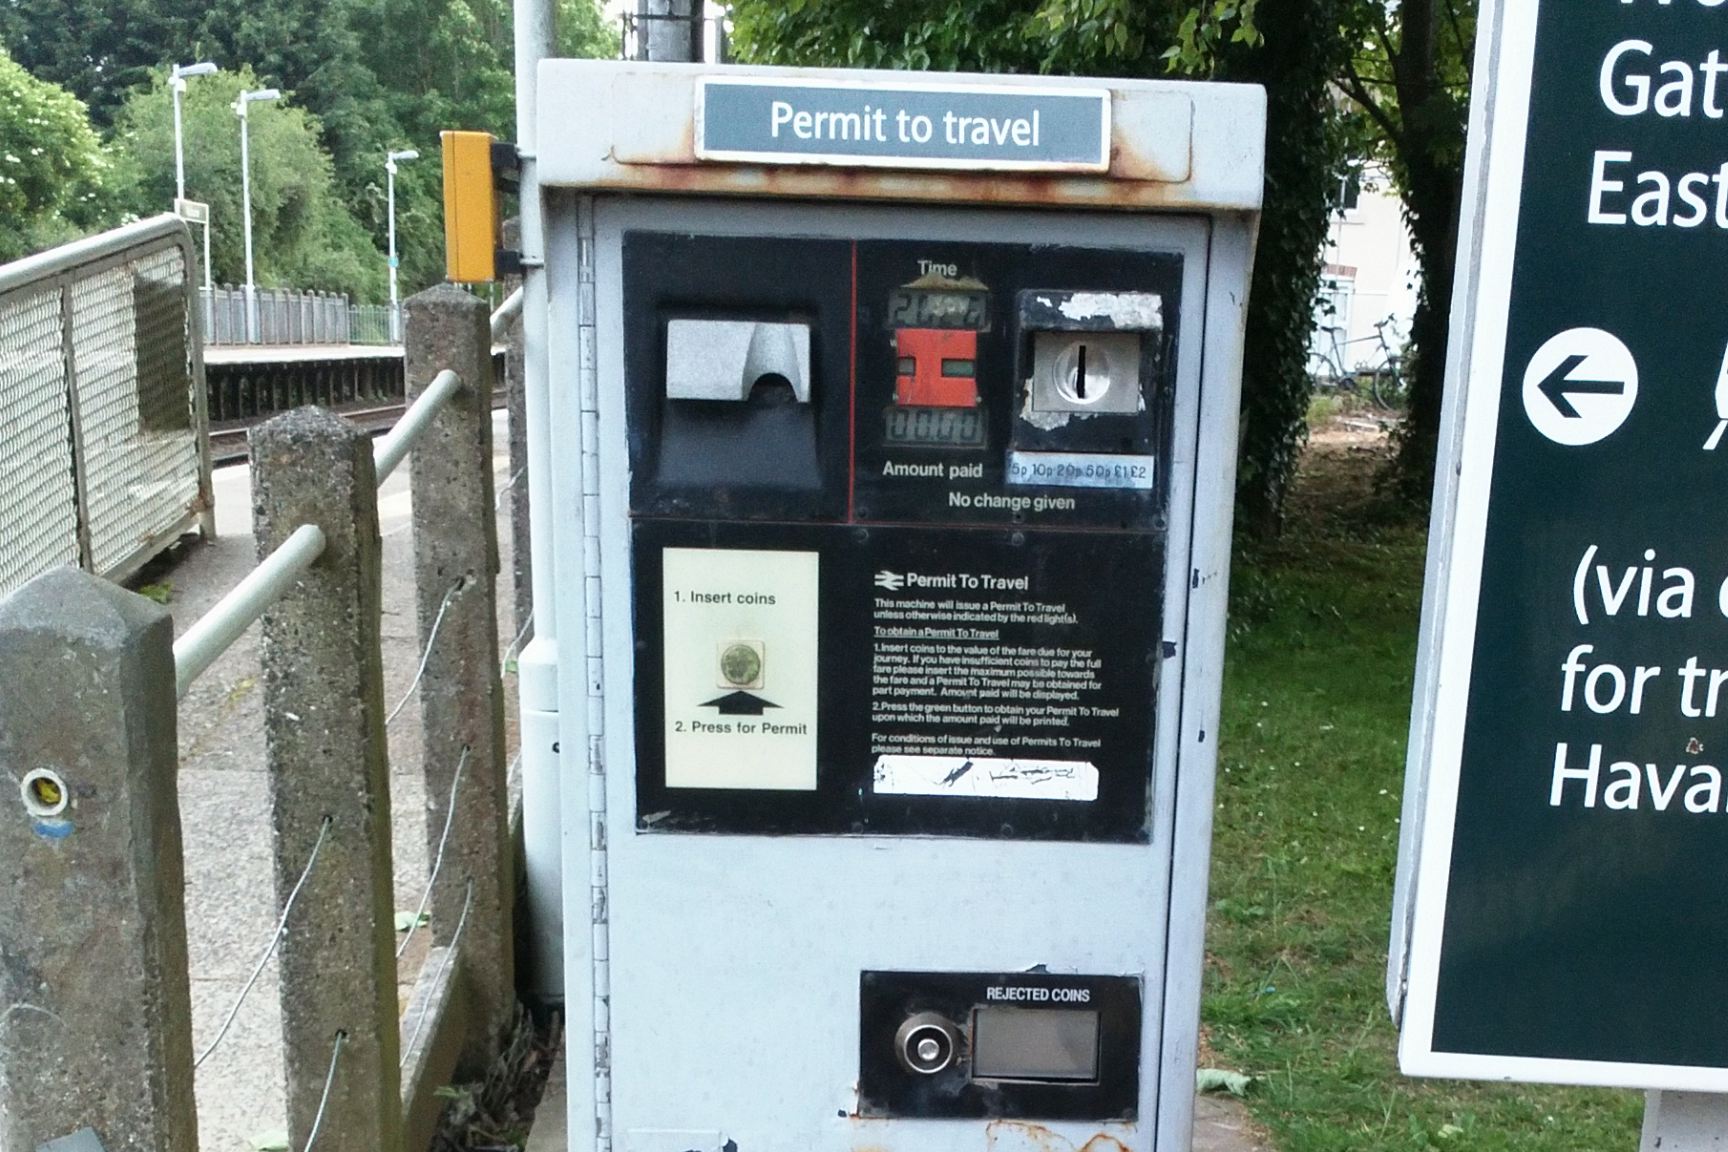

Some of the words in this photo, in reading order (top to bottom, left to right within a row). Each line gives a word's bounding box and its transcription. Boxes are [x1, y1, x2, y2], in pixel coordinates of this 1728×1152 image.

[1600, 39, 1728, 119] Gat
[771, 100, 887, 142] Permit
[898, 109, 933, 144] to
[943, 110, 1040, 147] travel
[918, 260, 957, 276] Time
[883, 461, 944, 477] Amount
[949, 462, 983, 478] paid
[1032, 463, 1053, 478] 10p
[1056, 463, 1083, 478] 20p
[1085, 464, 1111, 479] 50p
[949, 491, 970, 507] No
[974, 493, 1031, 512] change
[1034, 494, 1075, 512] given
[907, 573, 957, 589] Permit
[959, 573, 979, 589] To
[981, 574, 1028, 591] Travel
[1573, 545, 1695, 625] (via
[674, 591, 685, 602] 1.
[690, 590, 732, 604] Insert
[737, 592, 776, 605] coins
[875, 598, 895, 608] This
[896, 599, 935, 609] machine
[938, 600, 954, 609] will
[956, 600, 981, 610] issue
[982, 602, 989, 610] a
[990, 601, 1021, 611] Permit
[1023, 602, 1035, 612] To
[1035, 603, 1066, 613] Travel
[874, 610, 904, 619] unless
[905, 610, 952, 620] otherwise
[953, 611, 997, 621] indicated
[998, 613, 1008, 623] by
[1010, 613, 1026, 622] the
[1027, 614, 1043, 623] red
[874, 626, 886, 636] To
[924, 627, 955, 637] Permit
[957, 628, 969, 638] To
[970, 628, 999, 639] Travel
[909, 643, 935, 653] coins
[936, 644, 946, 653] to
[947, 645, 962, 654] the
[964, 645, 988, 655] value
[989, 646, 1000, 655] of
[1001, 646, 1016, 655] the
[1018, 647, 1036, 656] fare
[1037, 647, 1055, 656] due
[1056, 648, 1070, 657] for
[1071, 649, 1093, 659] your
[913, 654, 919, 663] If
[920, 656, 937, 665] you
[939, 655, 962, 664] have
[962, 655, 1013, 666] insufficient
[1014, 657, 1039, 666] coins
[1041, 657, 1050, 667] to
[1052, 659, 1069, 669] pay
[1070, 658, 1085, 668] the
[1086, 659, 1102, 668] full
[873, 664, 892, 673] fare
[893, 664, 923, 675] please
[925, 665, 952, 675] insert
[953, 666, 968, 675] the
[970, 667, 1015, 677] maximum
[1017, 668, 1056, 678] possible
[1057, 669, 1095, 679] towards
[1561, 644, 1660, 714] for
[873, 674, 888, 684] the
[890, 675, 908, 685] fare
[910, 675, 928, 685] and
[936, 676, 967, 686] Permit
[968, 677, 980, 686] To
[982, 677, 1010, 687] Travel
[1011, 680, 1031, 690] may
[1032, 679, 1044, 688] be
[1046, 680, 1087, 689] obtained
[1089, 680, 1102, 690] for
[872, 686, 892, 696] part
[940, 687, 977, 697] Amount
[979, 688, 999, 698] paid
[1001, 689, 1017, 698] will
[1020, 690, 1031, 699] be
[909, 702, 923, 712] the
[925, 704, 951, 714] green
[953, 703, 982, 713] button
[984, 704, 994, 713] to
[995, 705, 1024, 714] obtain
[1025, 707, 1045, 716] your
[1046, 705, 1077, 716] Permit
[1078, 706, 1090, 716] To
[1091, 707, 1119, 717] Travel
[872, 714, 895, 723] upon
[897, 713, 924, 723] which
[926, 714, 940, 723] the
[942, 715, 977, 724] amount
[980, 715, 1000, 725] paid
[1001, 716, 1017, 725] will
[1020, 716, 1032, 725] be
[675, 721, 687, 733] 2.
[692, 721, 731, 733] Press
[737, 721, 756, 733] for
[762, 722, 807, 735] Permit
[871, 733, 887, 742] For
[888, 734, 935, 743] conditions
[937, 735, 947, 743] of
[948, 735, 972, 744] issue
[974, 736, 991, 745] and
[992, 737, 1008, 745] use
[1010, 737, 1020, 745] of
[1059, 738, 1071, 747] To
[1073, 738, 1101, 748] Travel
[871, 744, 902, 754] please
[904, 746, 920, 754] see
[923, 746, 963, 755] separate
[1550, 743, 1728, 813] Hava
[987, 986, 1049, 1001] REJECTED
[1052, 988, 1090, 1003] COINS
